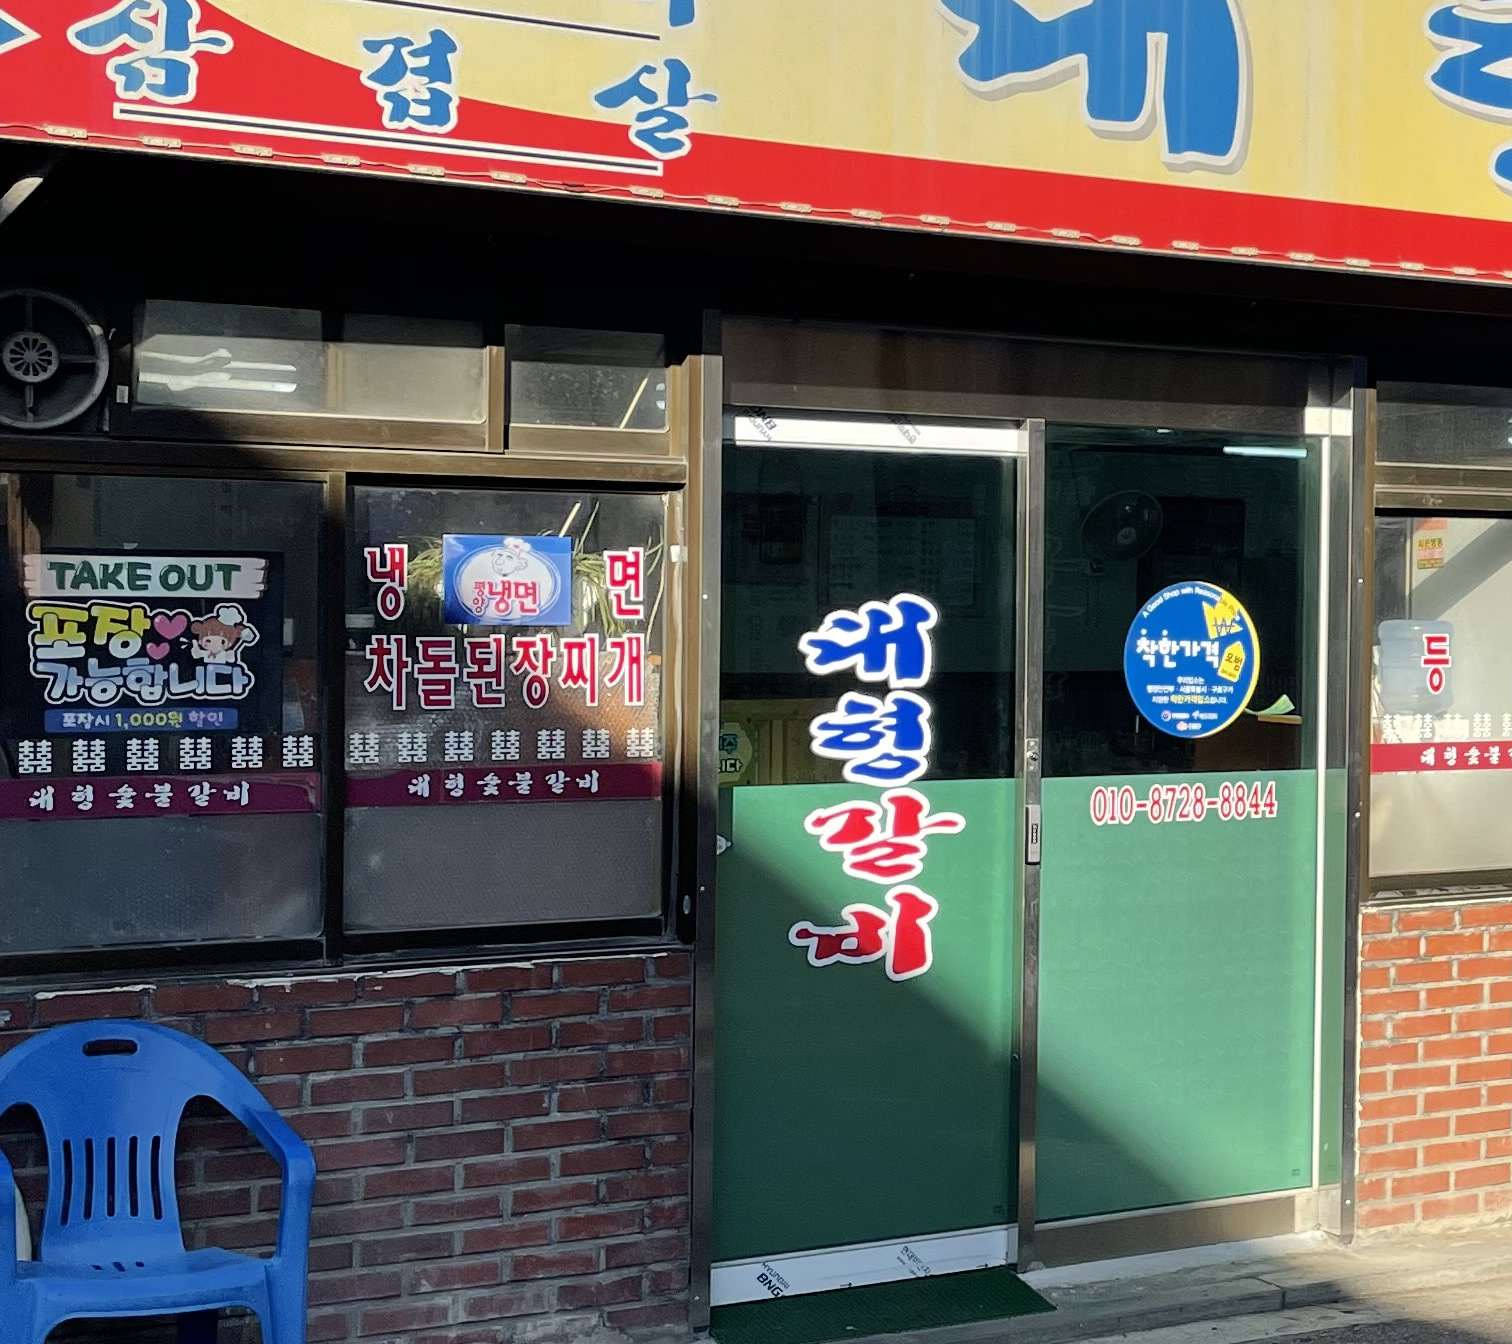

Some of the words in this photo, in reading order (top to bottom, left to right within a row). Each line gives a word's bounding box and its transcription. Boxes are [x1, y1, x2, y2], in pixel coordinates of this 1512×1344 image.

[46, 559, 153, 592] TAKE
[158, 561, 242, 592] OUT
[487, 580, 541, 617] 냉면
[30, 603, 152, 660] 포장
[1135, 629, 1220, 669] 착한가격
[35, 657, 251, 702] 가능합니다
[61, 711, 110, 728] 포장시
[115, 711, 184, 729] 1,000원
[187, 710, 225, 728] 할인
[1090, 780, 1278, 826] 010-8728-8844
[760, 1261, 791, 1290] HYUNDAI
